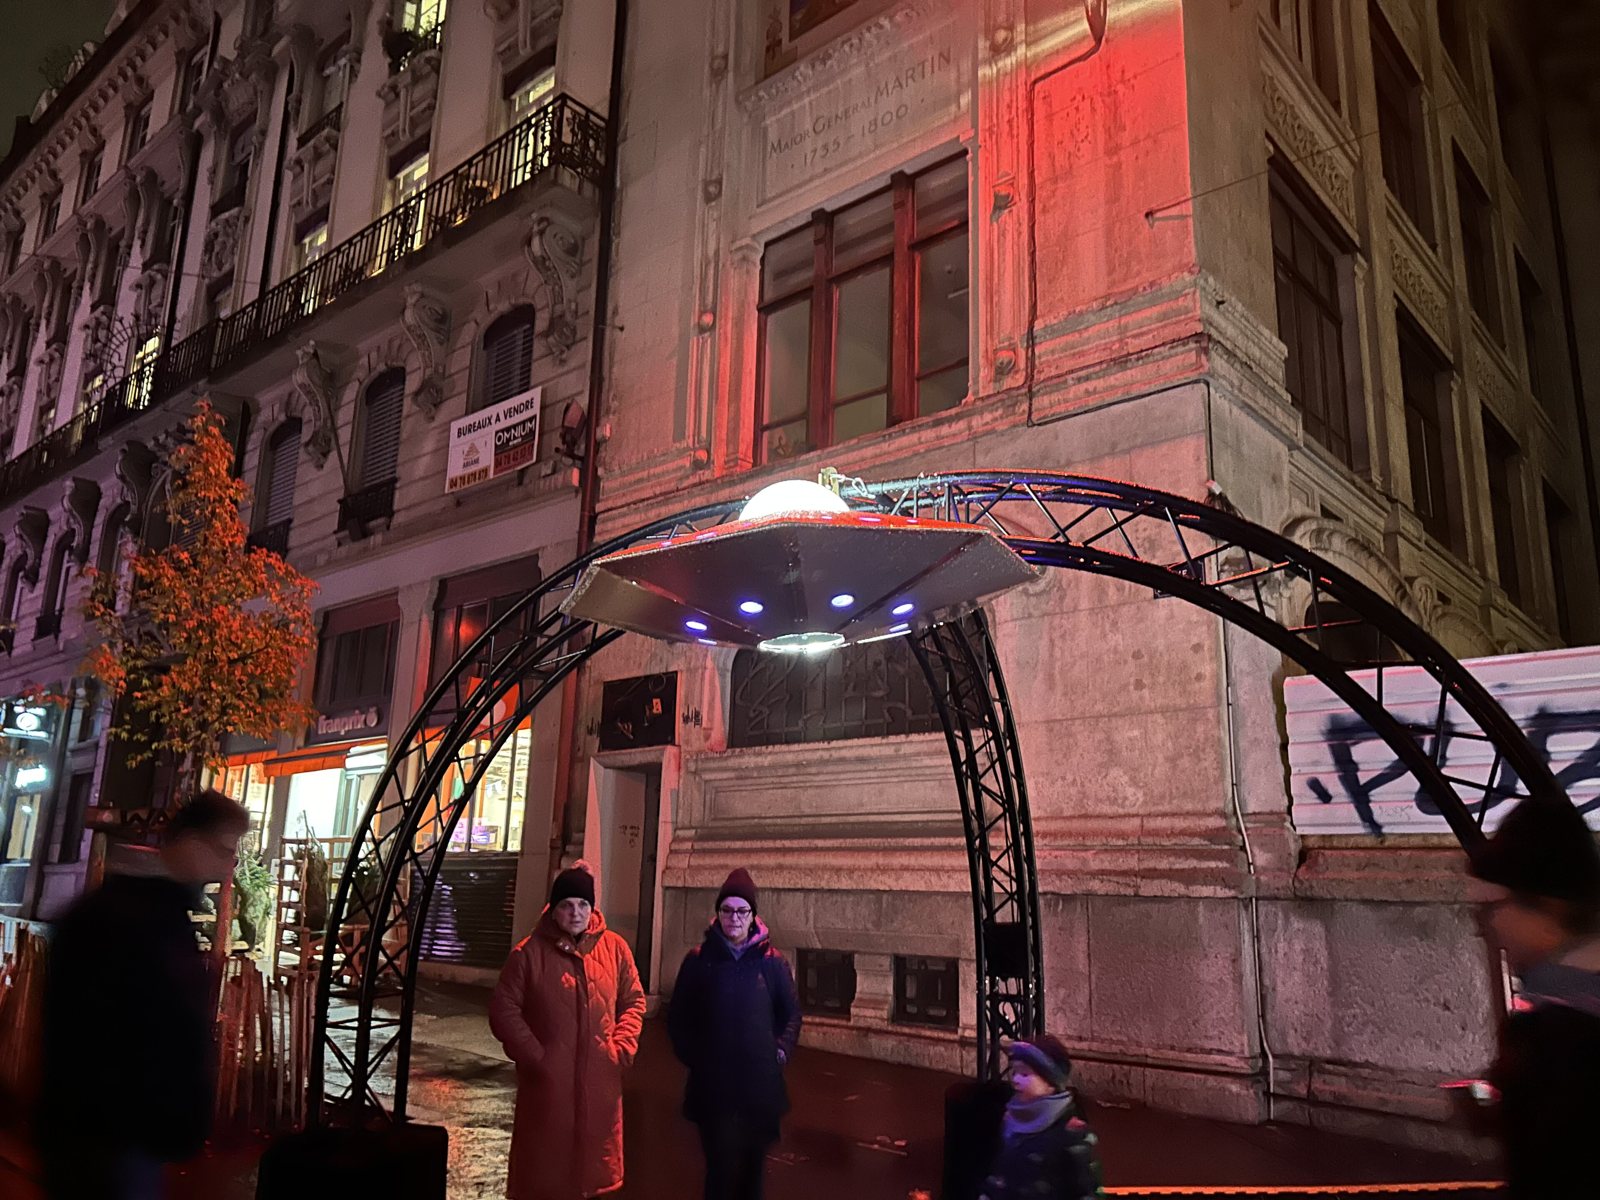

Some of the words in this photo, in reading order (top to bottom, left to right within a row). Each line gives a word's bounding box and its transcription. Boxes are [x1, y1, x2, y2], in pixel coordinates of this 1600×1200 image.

[874, 51, 950, 103] MARTIN
[457, 415, 492, 438] BUREAUX
[494, 413, 501, 425] A
[503, 398, 535, 420] VENDRE
[495, 419, 536, 446] OMNIUM
[318, 709, 366, 735] franprix
